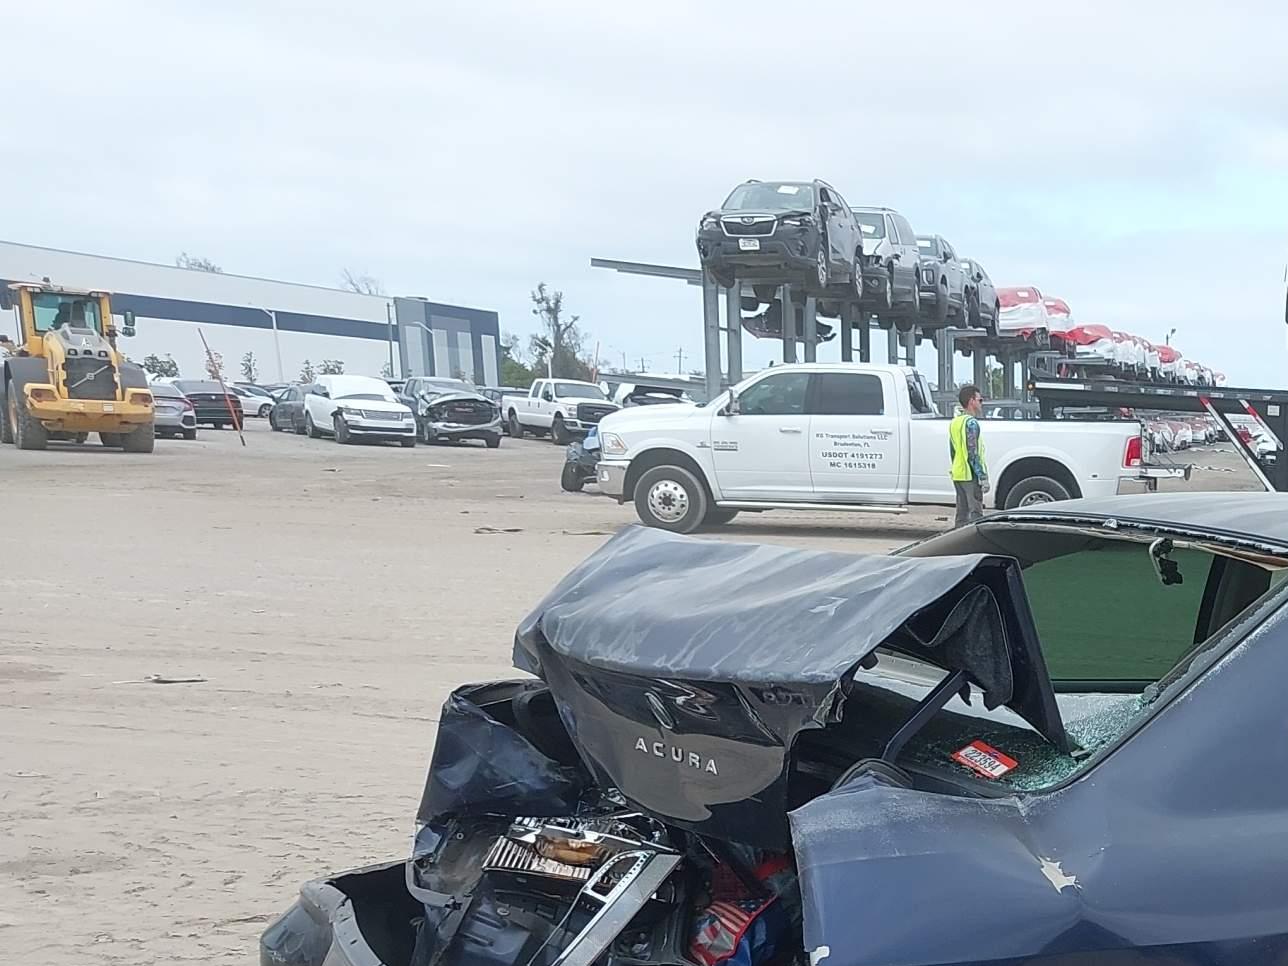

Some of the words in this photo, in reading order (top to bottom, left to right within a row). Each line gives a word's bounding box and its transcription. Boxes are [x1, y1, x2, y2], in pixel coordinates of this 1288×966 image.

[821, 451, 848, 459] USDOT
[829, 461, 842, 469] MC
[635, 737, 719, 775] ACURA
